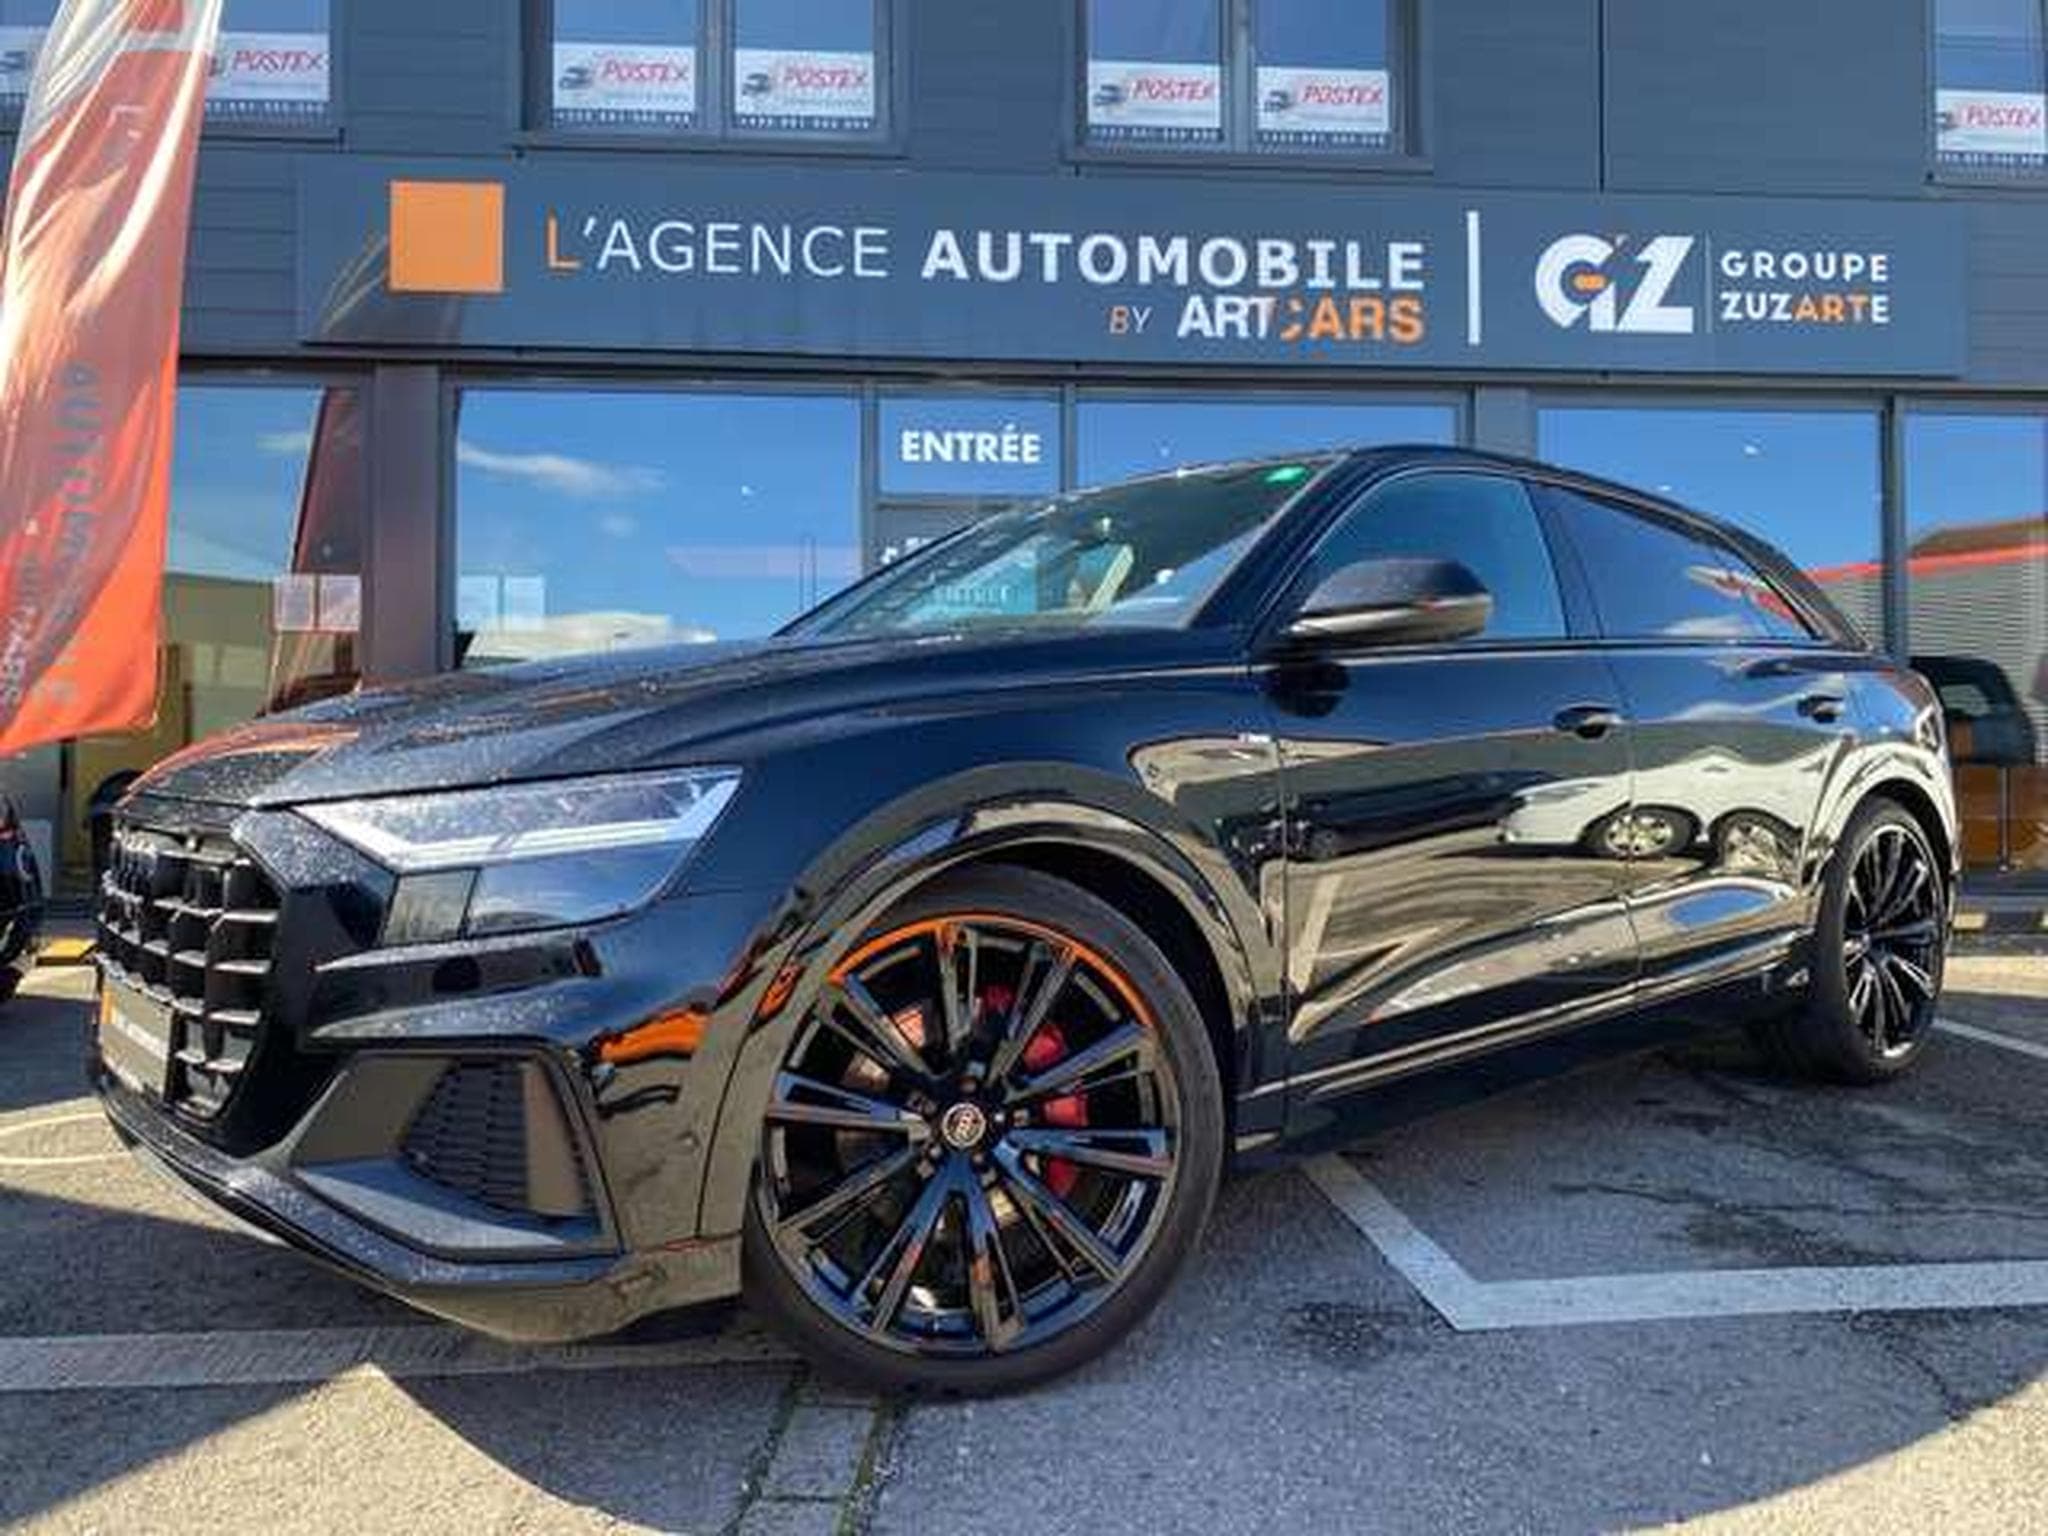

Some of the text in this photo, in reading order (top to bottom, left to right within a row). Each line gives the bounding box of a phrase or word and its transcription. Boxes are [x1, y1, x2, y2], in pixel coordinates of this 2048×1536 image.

[546, 212, 1425, 290] L'AGENCE AUTOMOBILE
[1720, 250, 1889, 282] GROUPE
[1109, 306, 1152, 335] BY
[1720, 290, 1889, 324] ZUZARTE
[901, 422, 1041, 464] ENTRÉE
